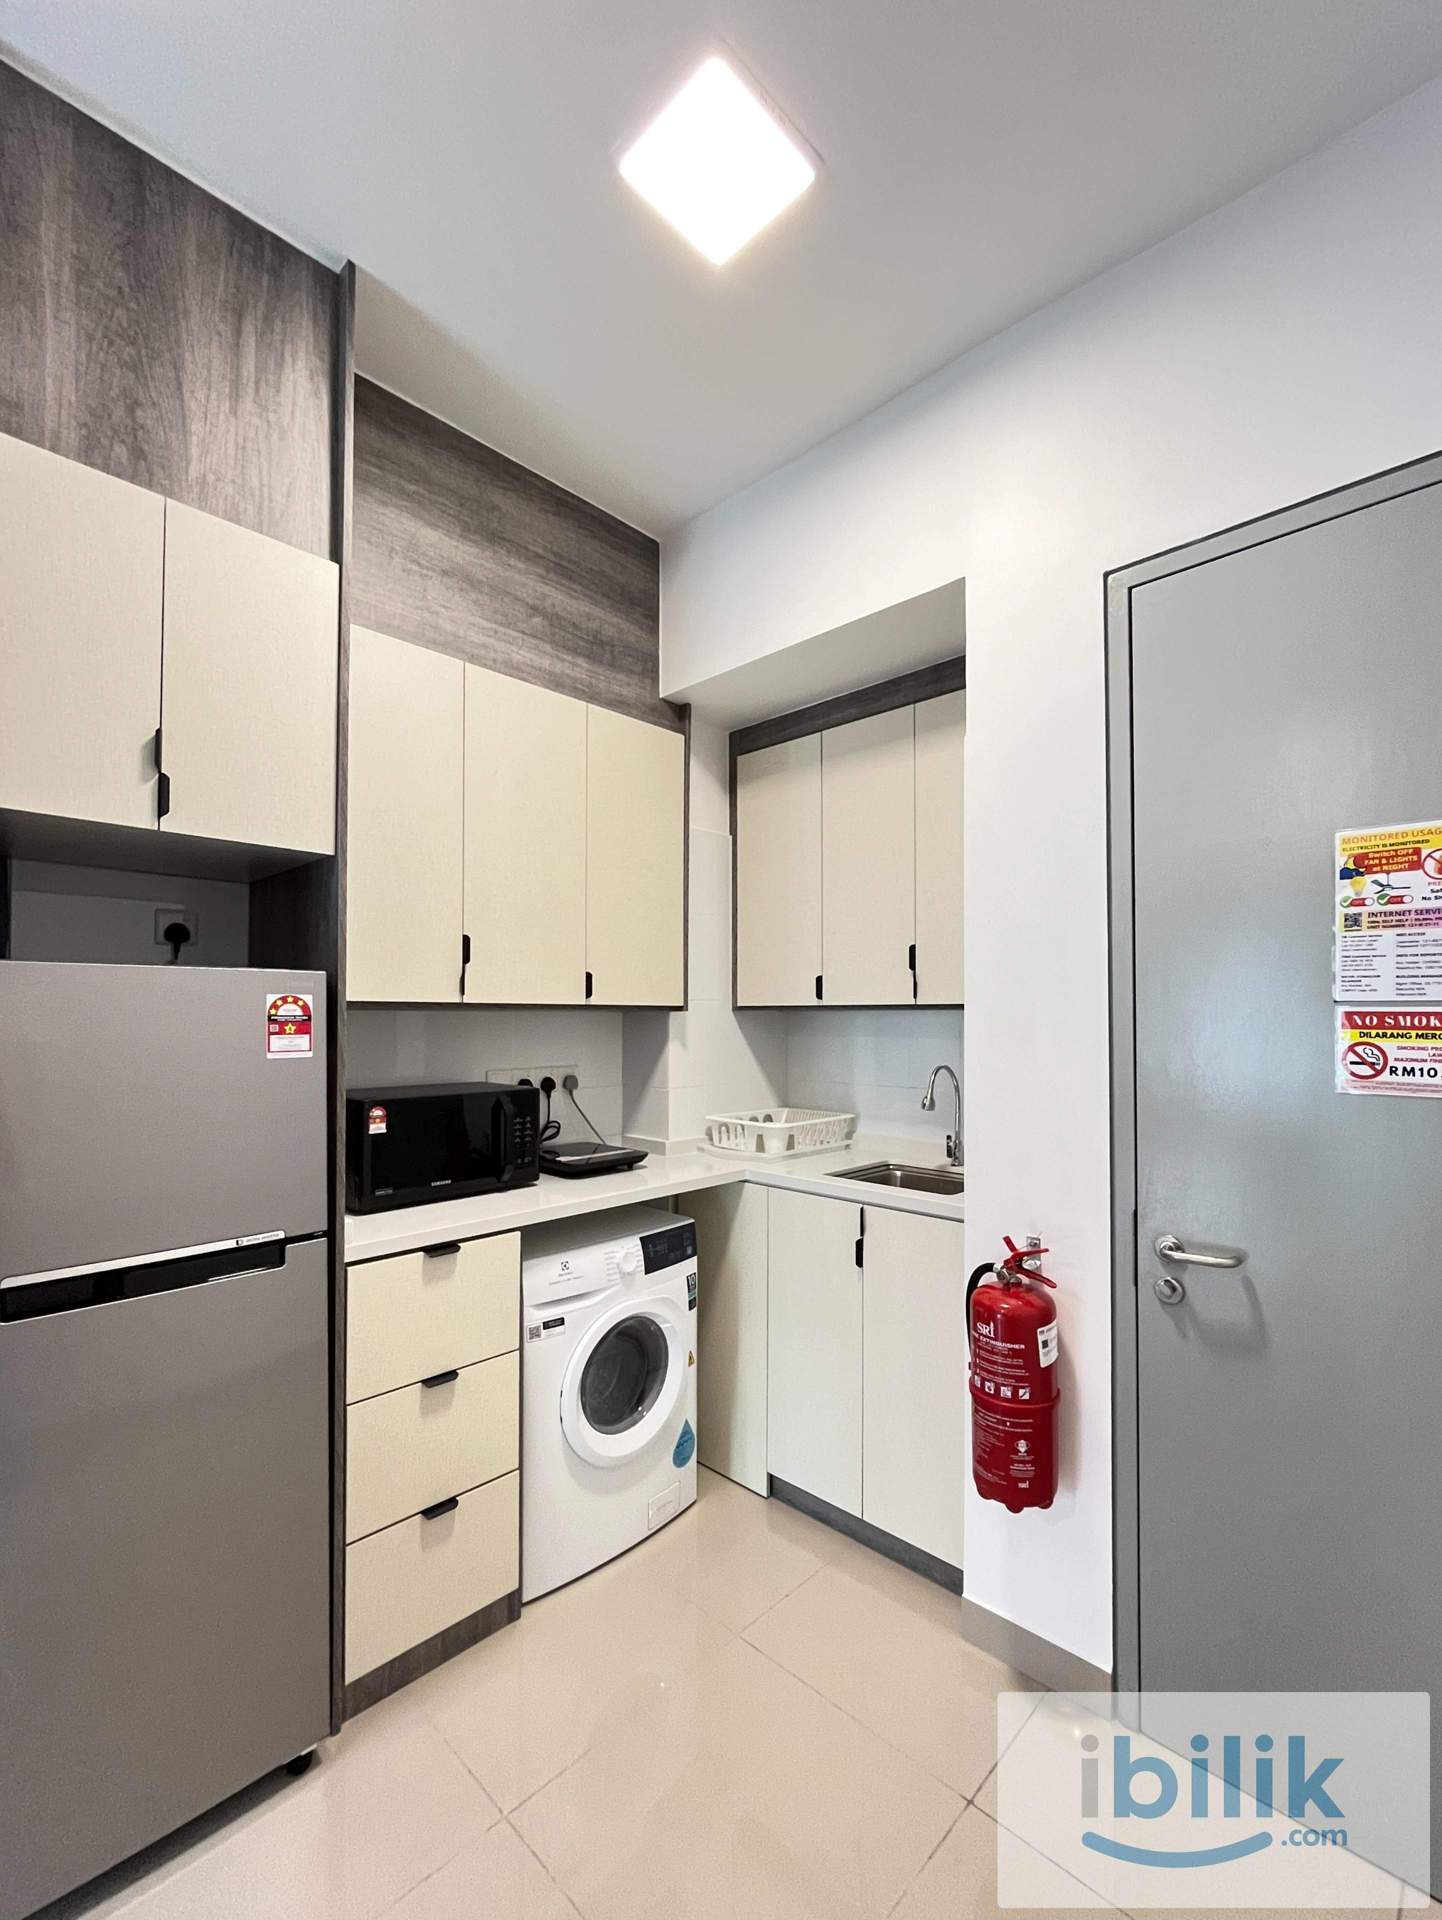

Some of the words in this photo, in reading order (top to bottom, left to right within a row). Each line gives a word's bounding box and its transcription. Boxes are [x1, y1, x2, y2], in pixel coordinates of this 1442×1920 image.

[1342, 831, 1409, 845] MONITORED
[1342, 844, 1380, 852] ELECTRICITY
[1389, 839, 1430, 847] MONITORED
[1368, 850, 1396, 858] Switch
[1397, 848, 1414, 856] OFF
[1389, 855, 1418, 863] LIGHTS
[1382, 863, 1409, 871] NIGHT
[1368, 909, 1412, 918] INTERNET
[1353, 1015, 1378, 1026] NO
[1384, 1015, 1442, 1027] SMOK
[1359, 1031, 1412, 1040] DILARANG
[979, 1335, 1025, 1349] EXTINGUISHER
